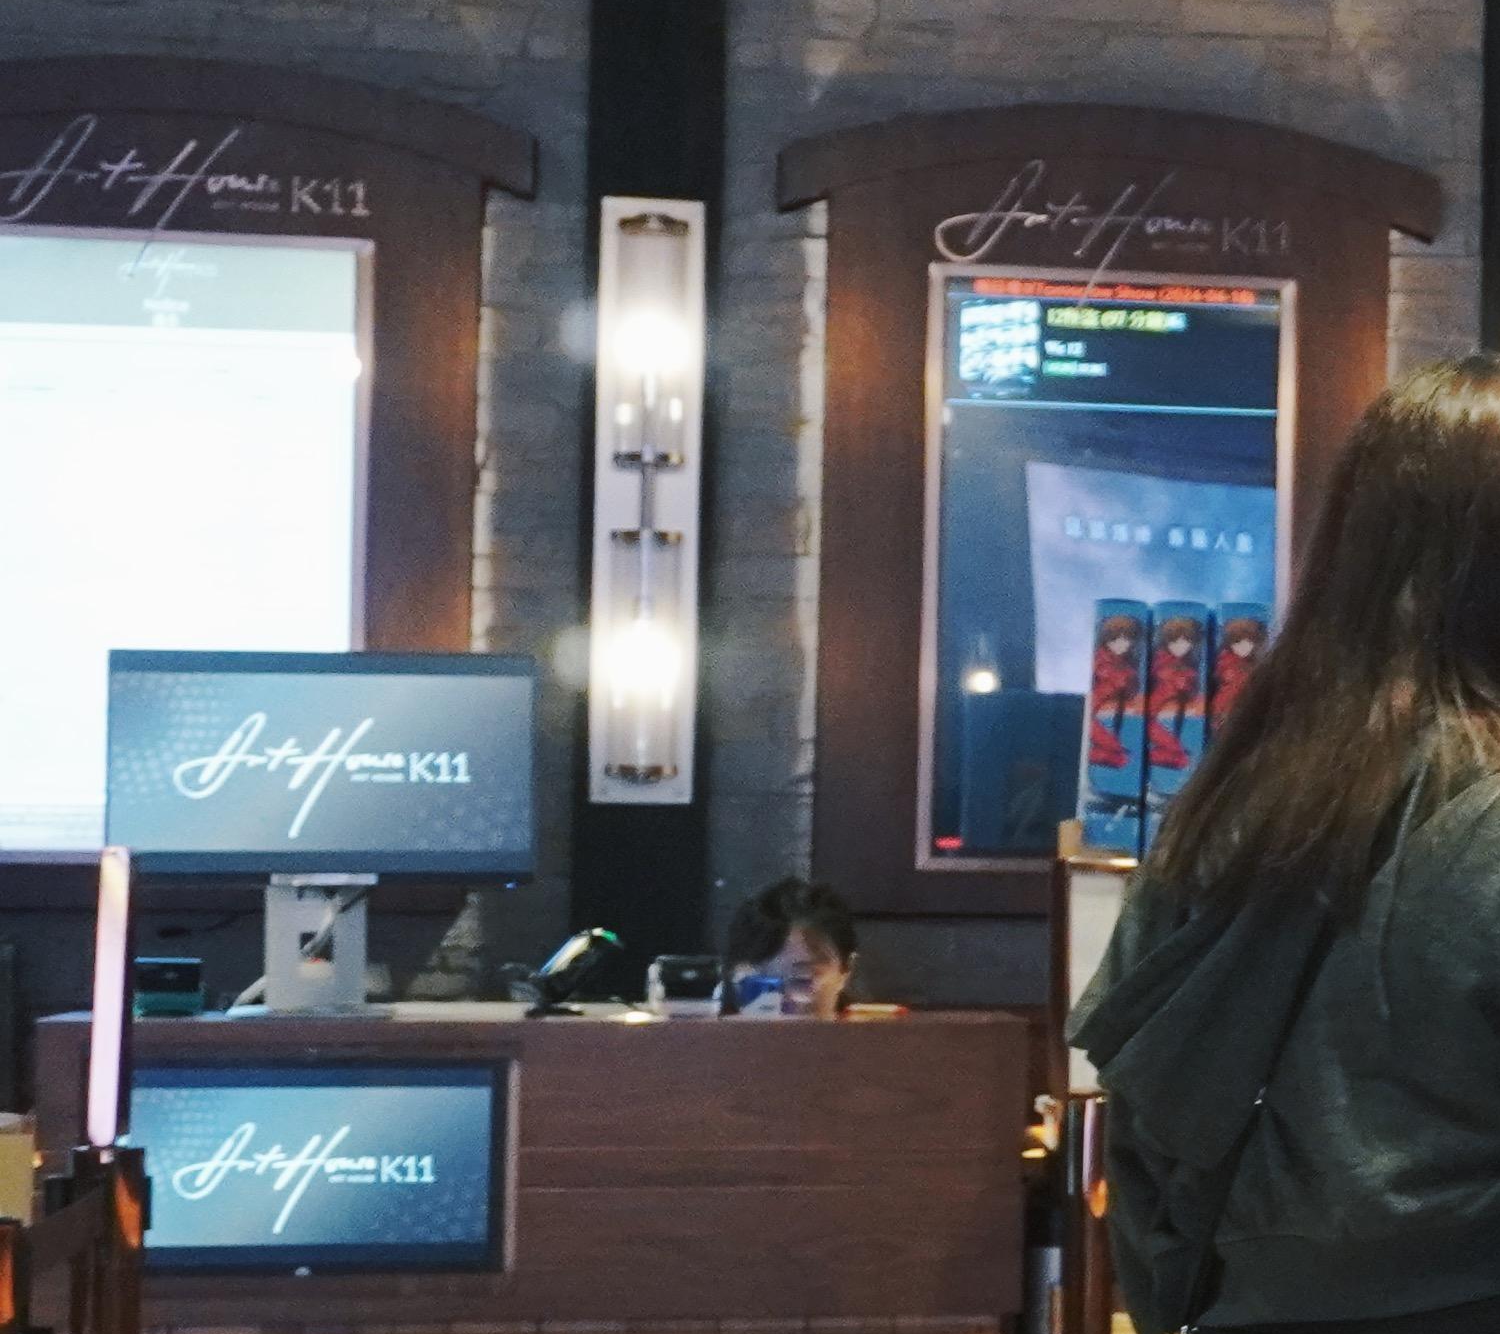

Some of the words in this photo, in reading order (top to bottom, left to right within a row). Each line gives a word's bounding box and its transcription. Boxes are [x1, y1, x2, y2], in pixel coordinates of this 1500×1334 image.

[290, 174, 372, 217] K11
[1222, 217, 1291, 254] K11
[409, 751, 471, 784] K11
[379, 1153, 438, 1184] K11
